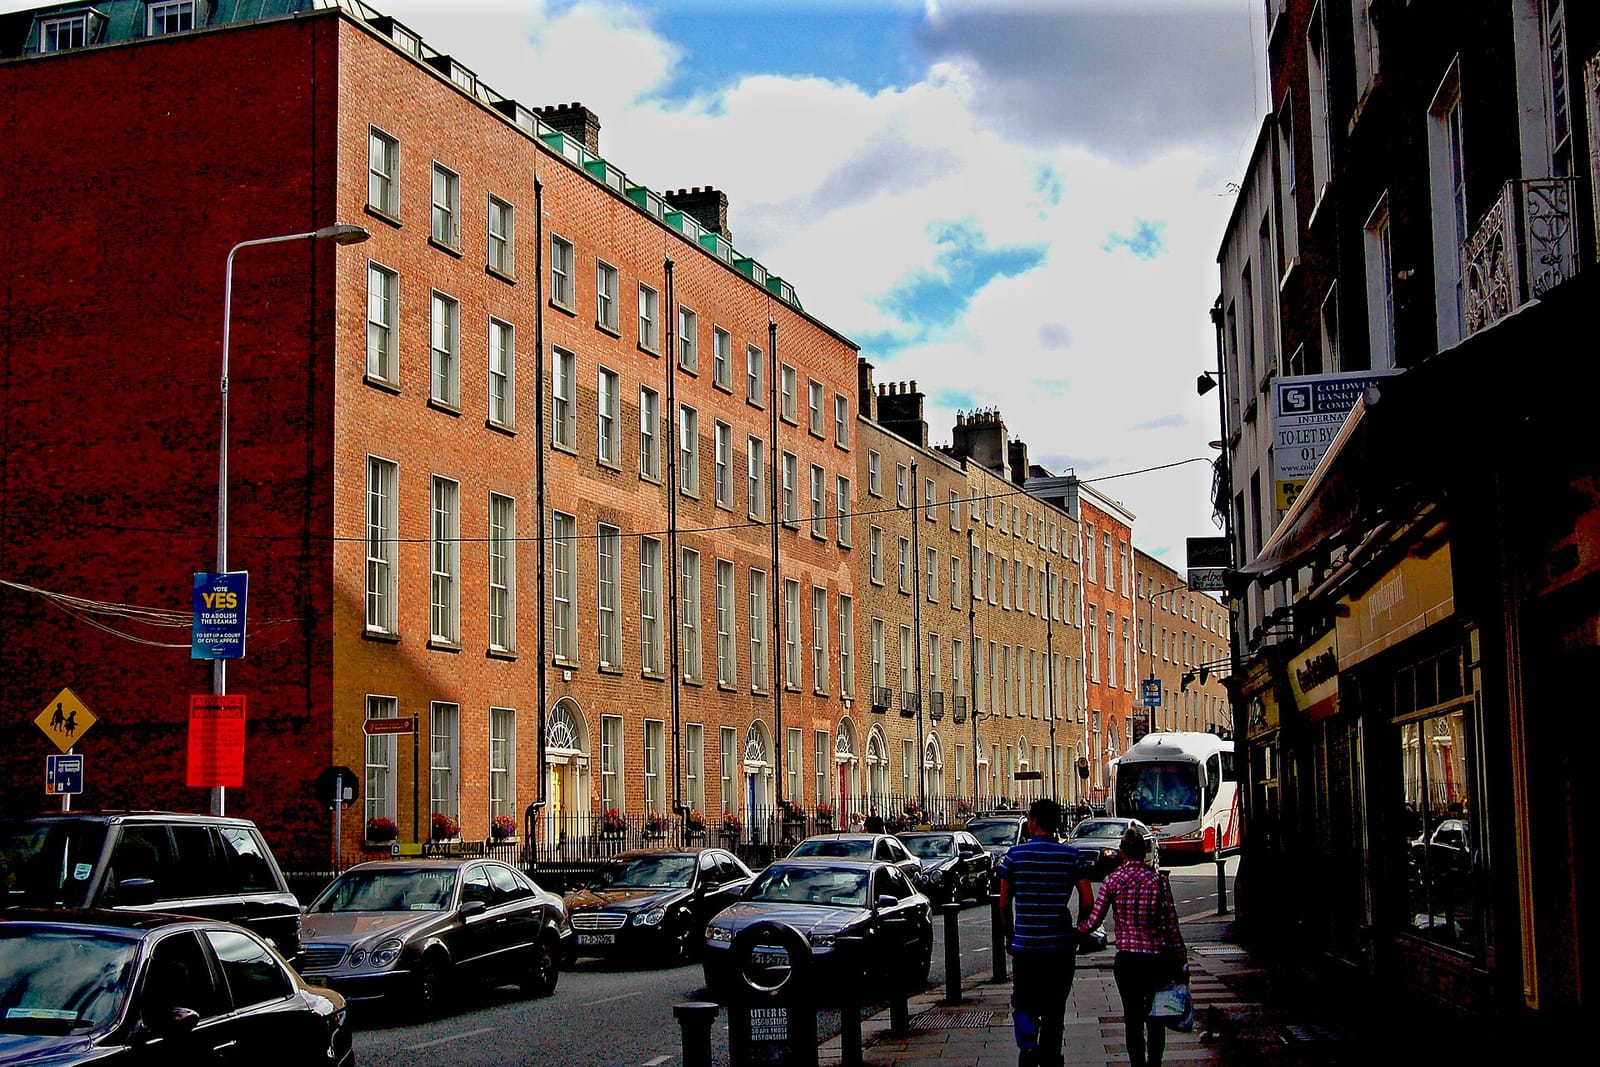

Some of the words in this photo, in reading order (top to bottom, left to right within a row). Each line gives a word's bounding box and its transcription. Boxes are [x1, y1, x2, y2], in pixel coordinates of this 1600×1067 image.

[1316, 381, 1379, 392] COLDWEL
[1279, 431, 1294, 445] TO
[1297, 428, 1317, 444] LET
[1320, 427, 1333, 442] BY
[202, 592, 238, 609] YES
[195, 698, 241, 707] ADVANCE
[194, 709, 241, 718] WARNING
[424, 843, 449, 854] TAXI
[750, 1008, 776, 1018] LITTER
[778, 1008, 787, 1017] IS
[751, 1018, 787, 1026] DISGUSTING
